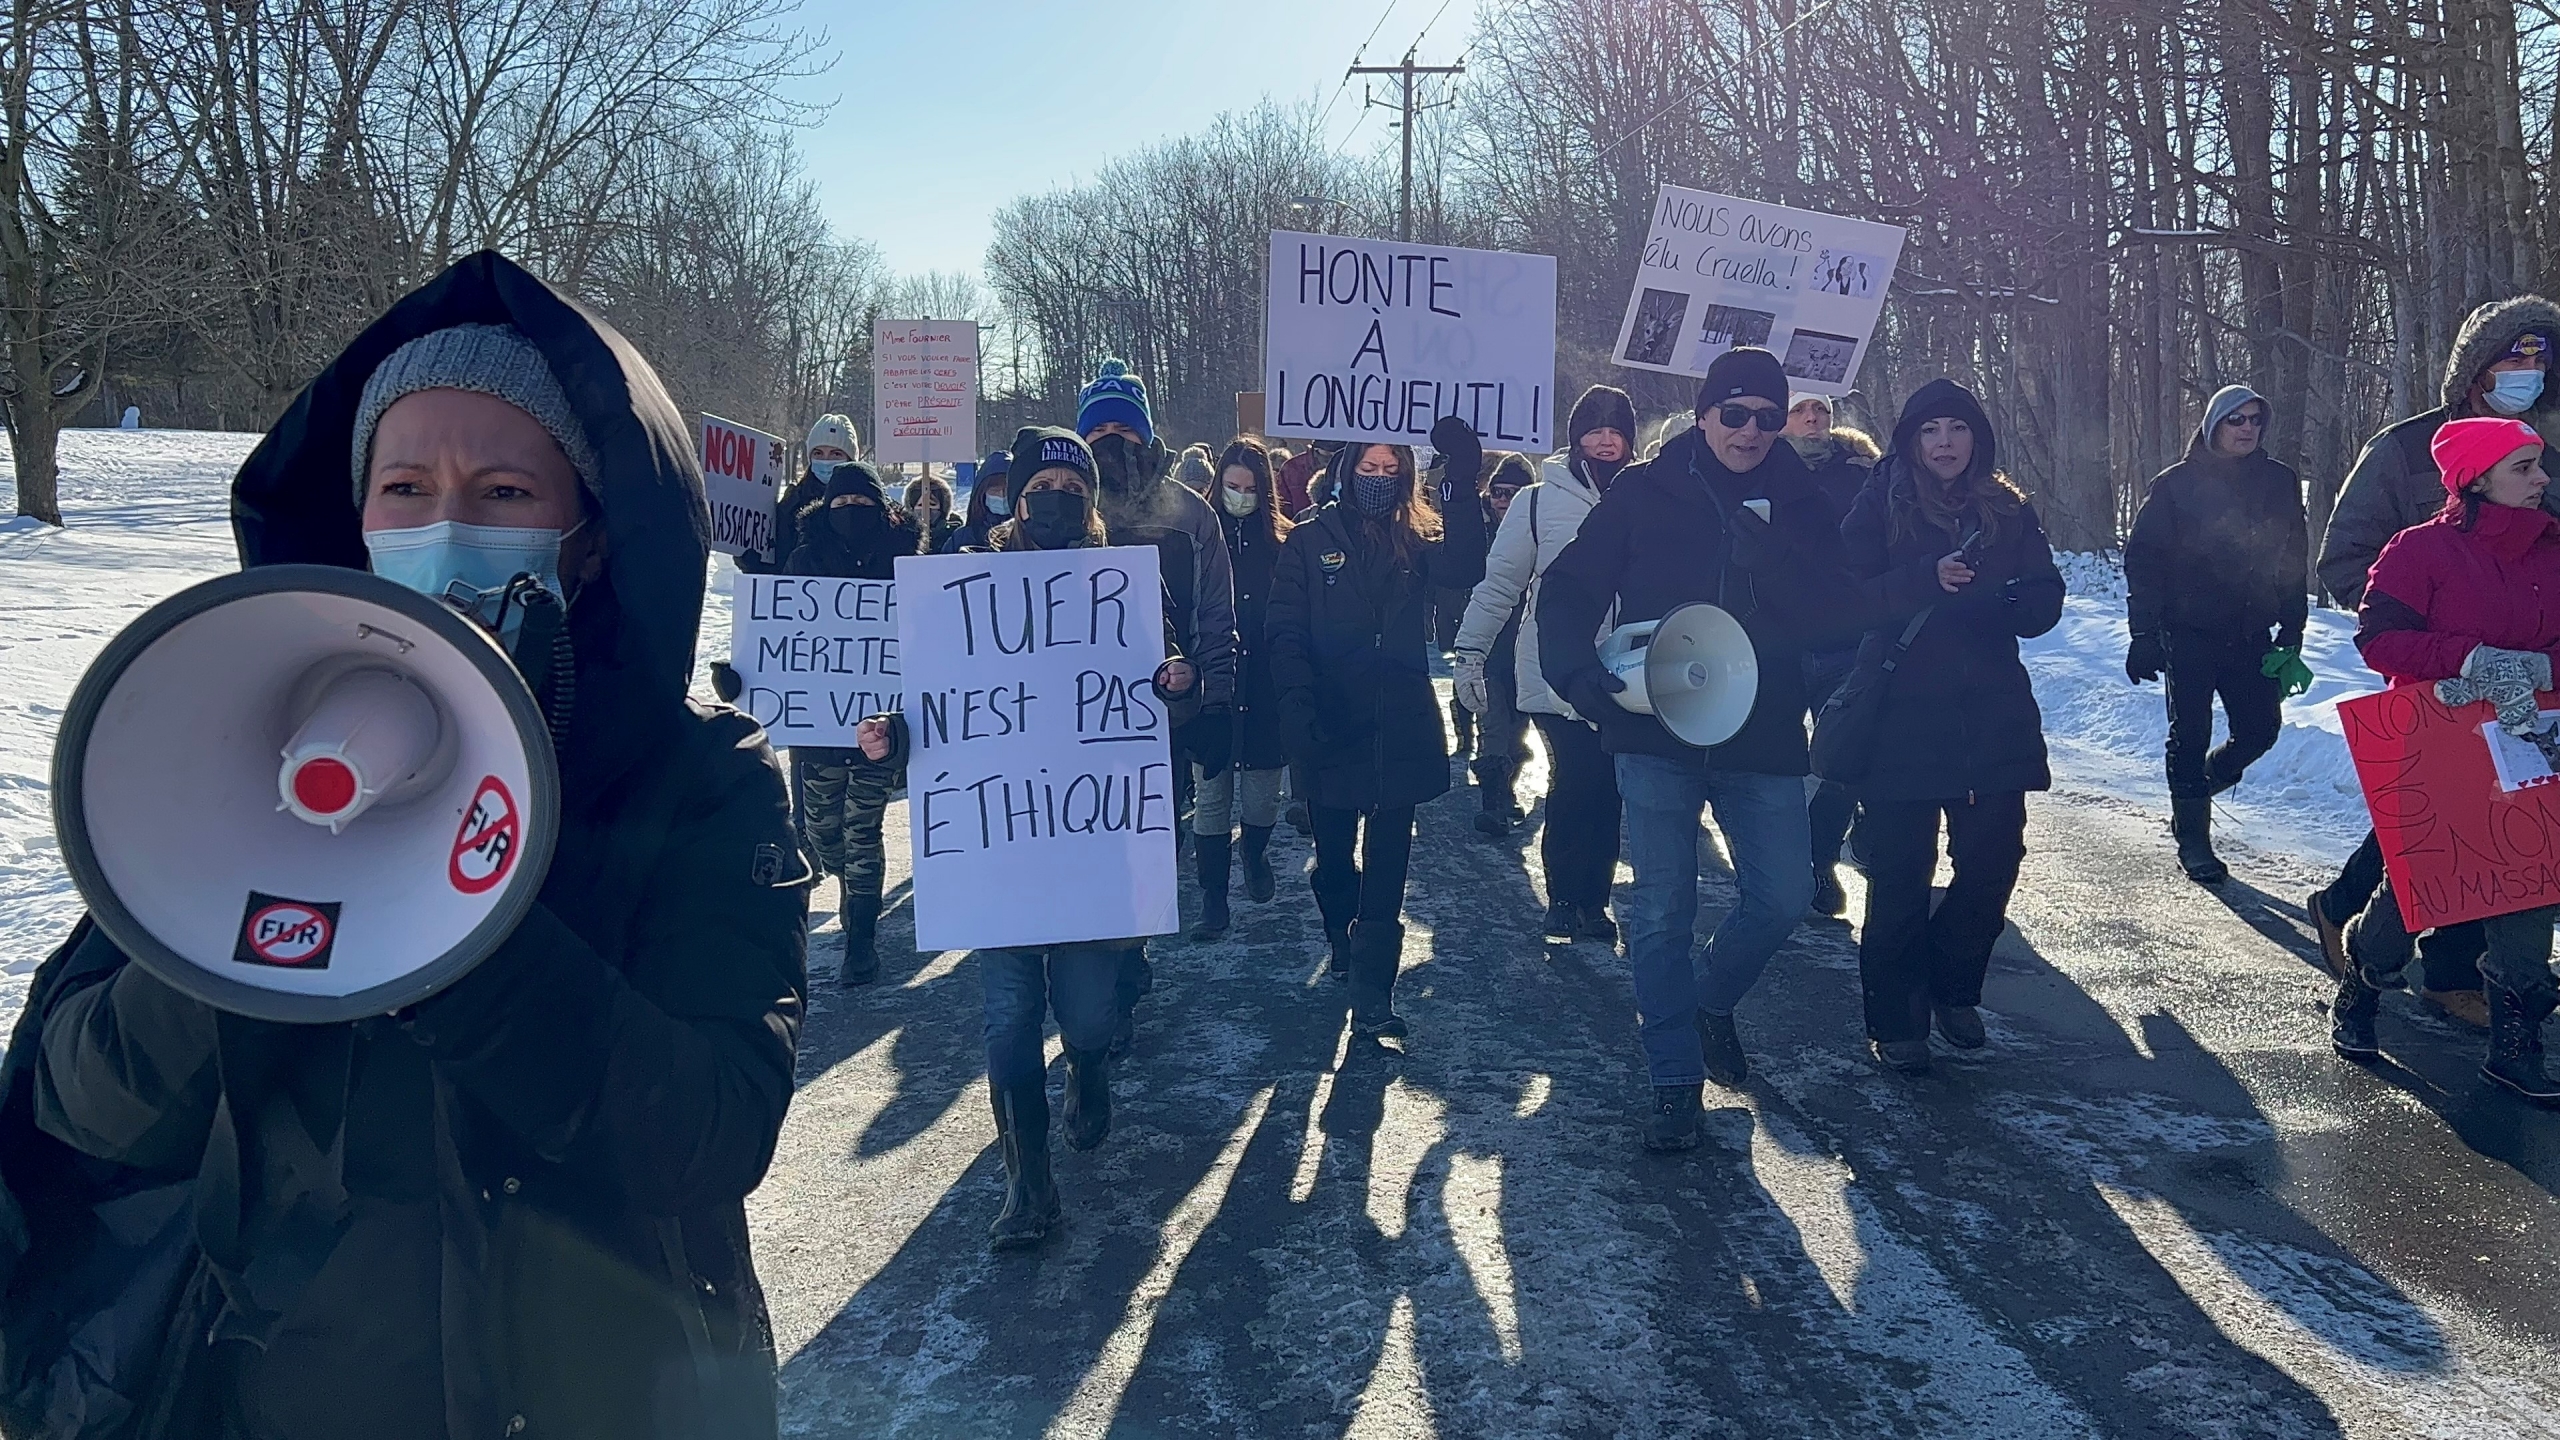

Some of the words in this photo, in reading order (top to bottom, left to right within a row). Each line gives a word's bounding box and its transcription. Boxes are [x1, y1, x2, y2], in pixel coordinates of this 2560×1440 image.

[1643, 237, 1680, 272] élu
[1739, 214, 1813, 253] avons
[1299, 243, 1461, 318] HONTE
[1350, 307, 1389, 374] À
[704, 424, 756, 482] NON
[1042, 440, 1090, 465] ANIMAL
[750, 578, 821, 622] LES
[943, 567, 1130, 657] TUER
[757, 630, 902, 676] MÉRITE
[749, 687, 815, 729] DE
[1075, 669, 1158, 734] PAS
[2349, 688, 2458, 746] NON
[2357, 749, 2446, 857] NON
[463, 799, 513, 872] FUR
[2408, 875, 2449, 925] AU
[258, 916, 319, 946] FUR
